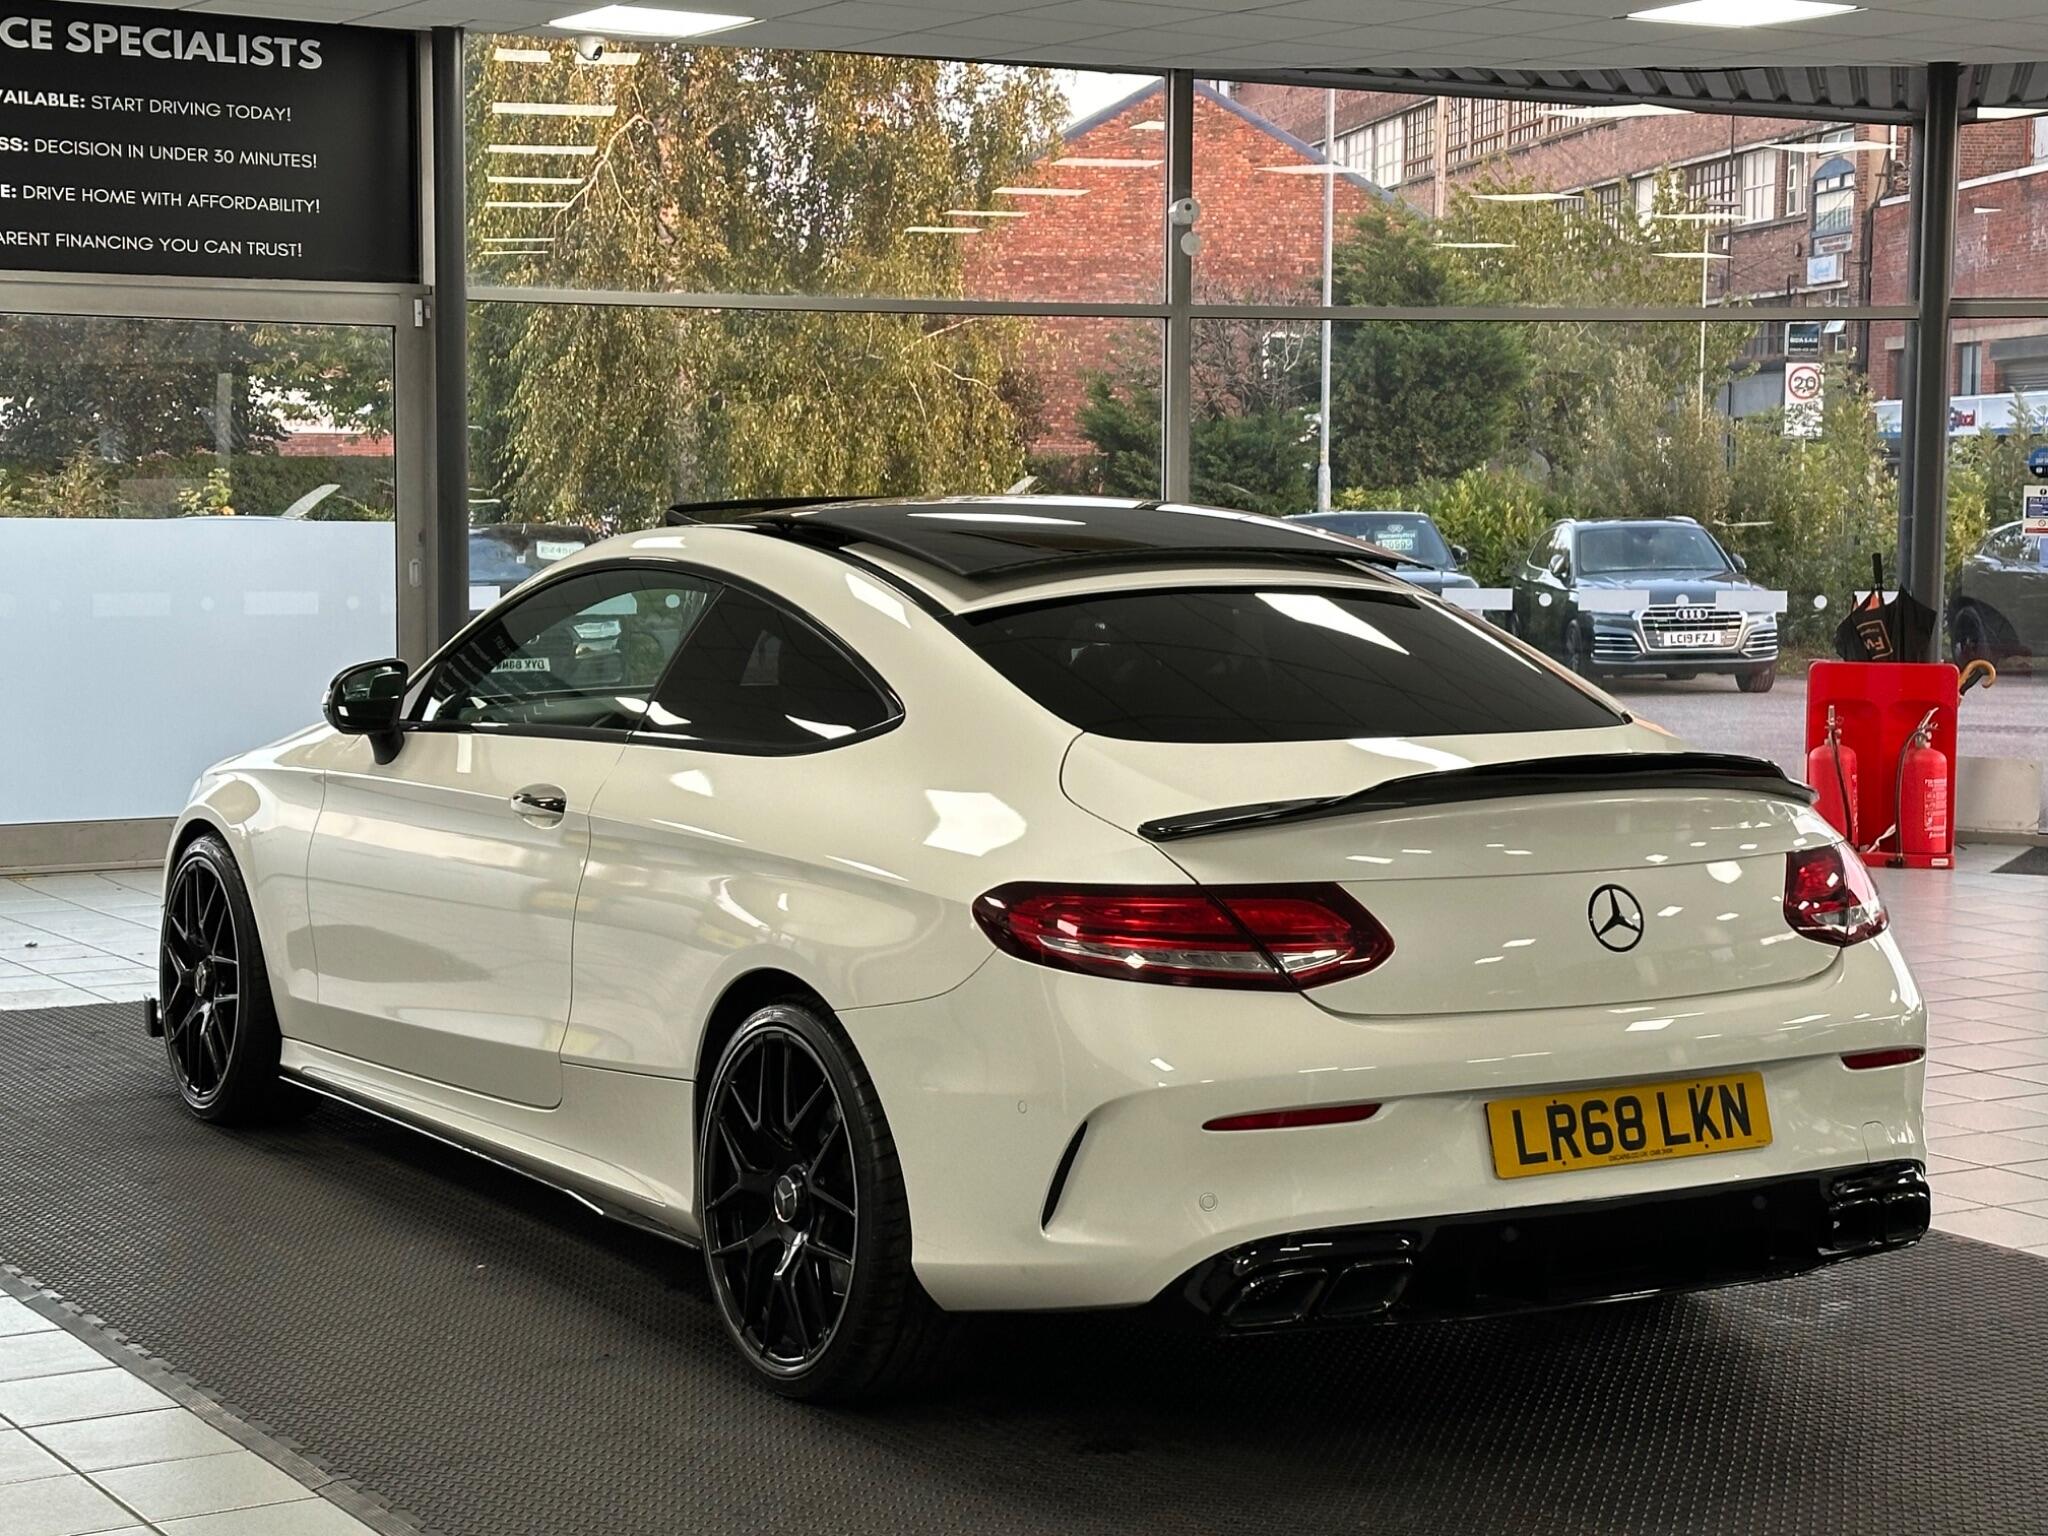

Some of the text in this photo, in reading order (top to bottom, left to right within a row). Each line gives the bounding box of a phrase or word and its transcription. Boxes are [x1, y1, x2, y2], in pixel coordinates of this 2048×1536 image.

[0, 16, 323, 69] CE SPECIALISTS
[0, 88, 291, 121] AILABLE: START DRIVING TODAY!
[34, 138, 122, 157] DECISION
[128, 144, 144, 158] IN
[150, 145, 208, 162] UNDER
[214, 149, 234, 163] 30
[239, 151, 317, 168] MINUTES!
[0, 184, 320, 213] E: DRIVE HOME WITH AFFORDABILITY!
[55, 233, 154, 250] FINANCING
[159, 238, 199, 252] YOU
[204, 240, 241, 254] CAN
[247, 242, 302, 257] TRUST!
[1793, 376, 1816, 389] 20
[1670, 632, 1715, 643] LC19 FZJ
[1511, 1083, 1752, 1166] LR68 LKN
